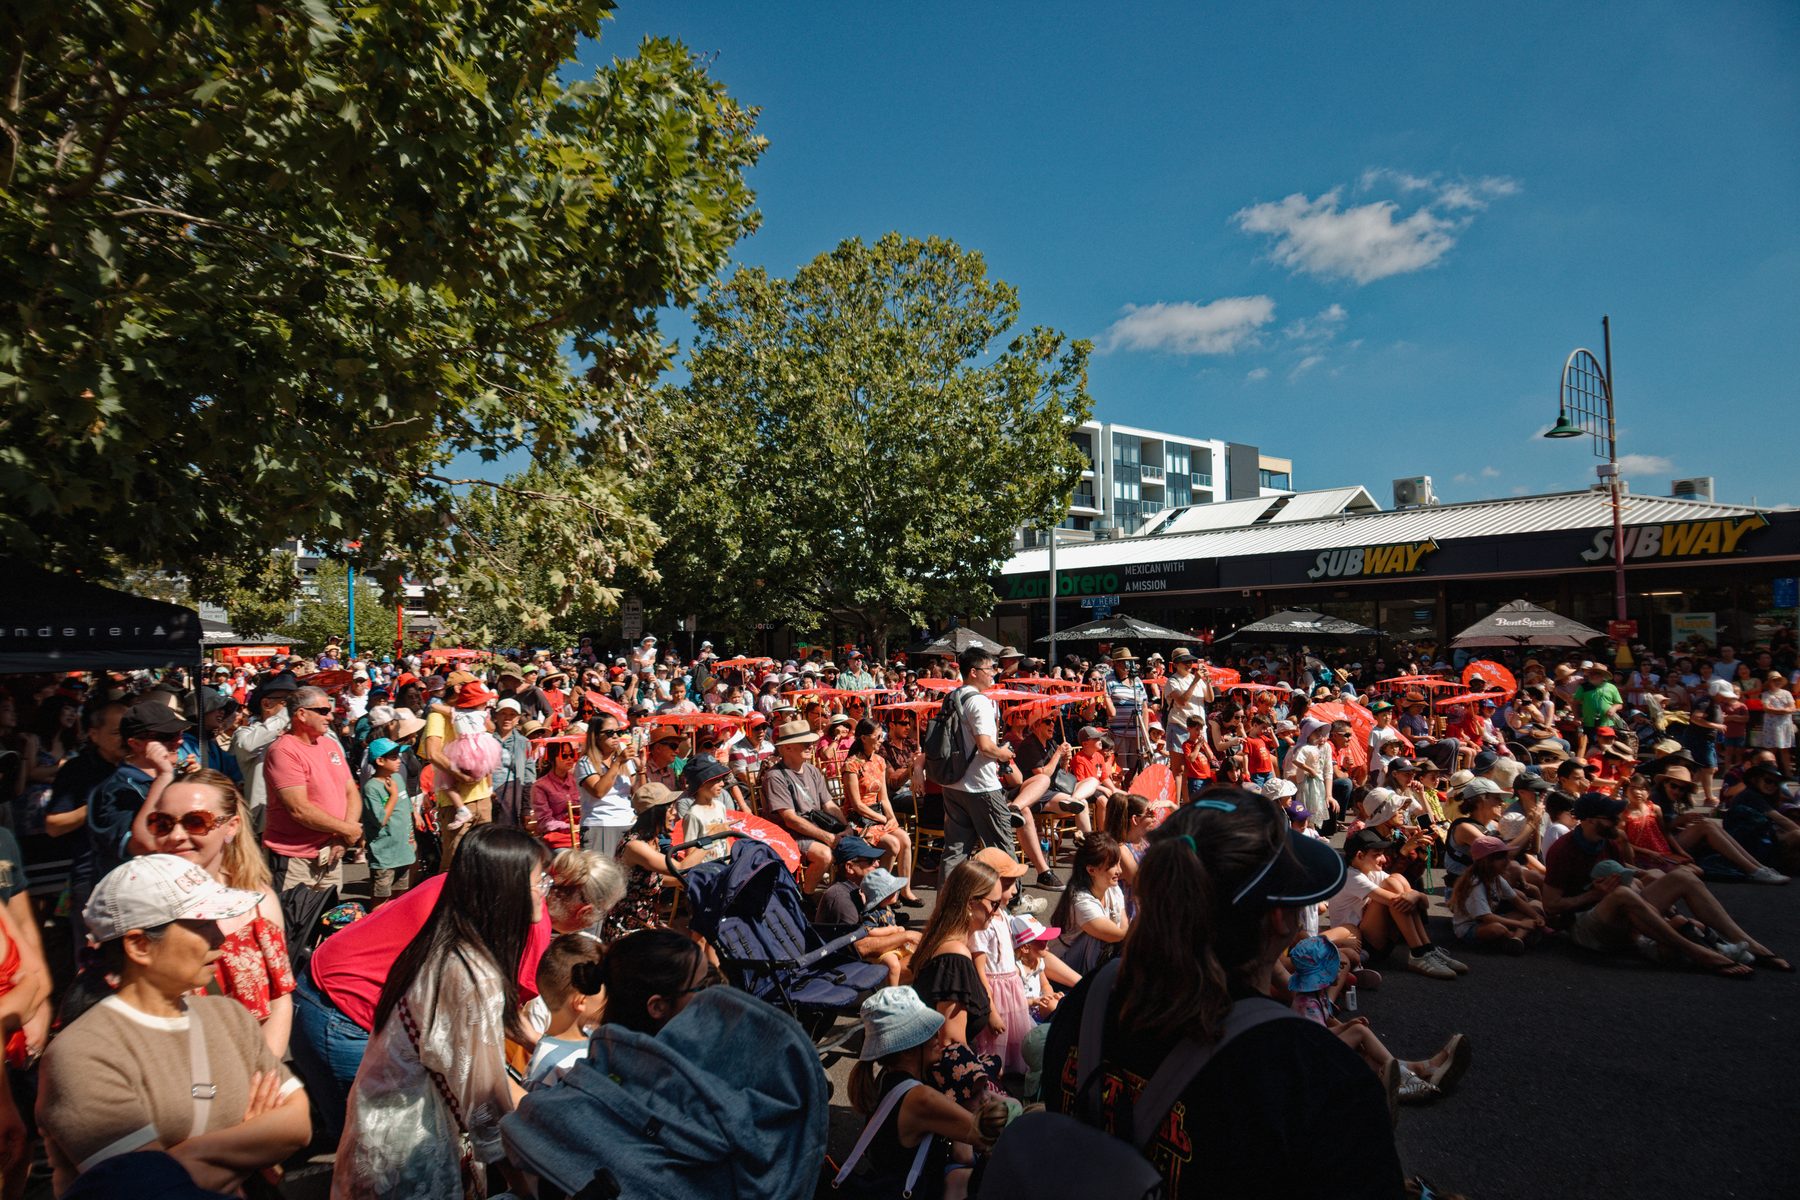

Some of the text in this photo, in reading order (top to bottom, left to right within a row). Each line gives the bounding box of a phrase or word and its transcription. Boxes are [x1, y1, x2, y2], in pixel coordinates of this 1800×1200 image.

[1580, 511, 1770, 562] SUBWAY
[1307, 536, 1440, 579] SUBWAY
[1125, 561, 1185, 575] MEXICAN WITH
[1125, 579, 1167, 592] A MISSION
[1082, 596, 1118, 606] PAY HERE
[1495, 617, 1555, 628] BentSpoke
